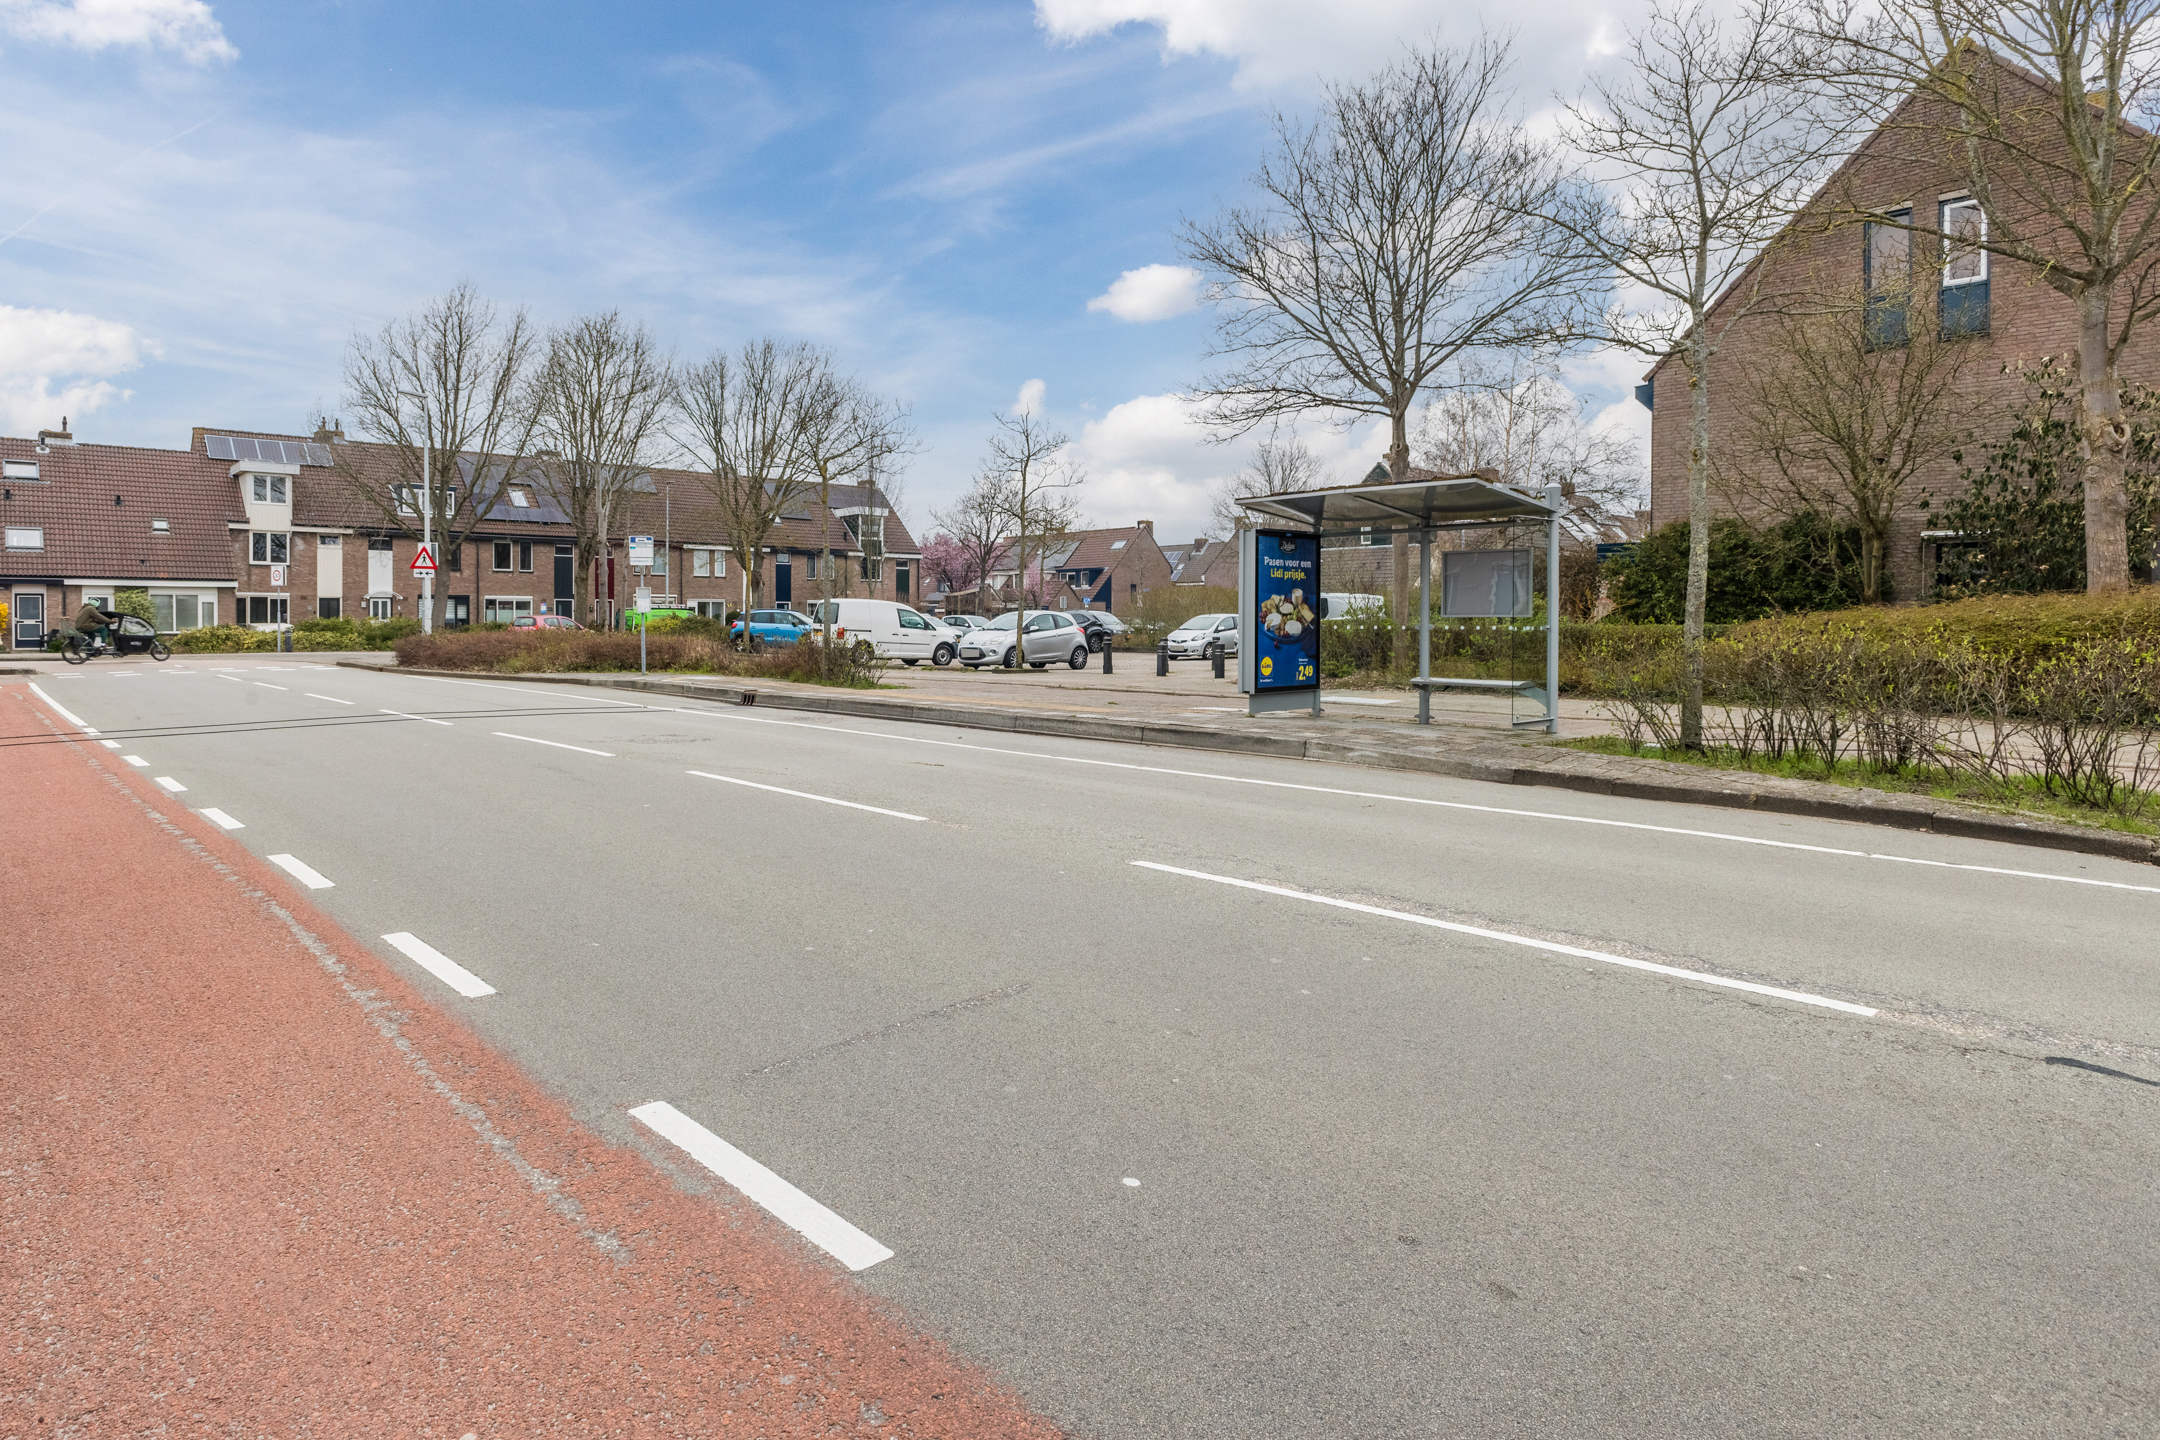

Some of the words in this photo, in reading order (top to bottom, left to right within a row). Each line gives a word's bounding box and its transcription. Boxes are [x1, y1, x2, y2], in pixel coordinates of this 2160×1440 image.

[1264, 556, 1284, 566] Pasen
[1270, 568, 1283, 578] Lidl
[1284, 569, 1306, 580] prijsje.
[1299, 665, 1313, 680] 2.49
